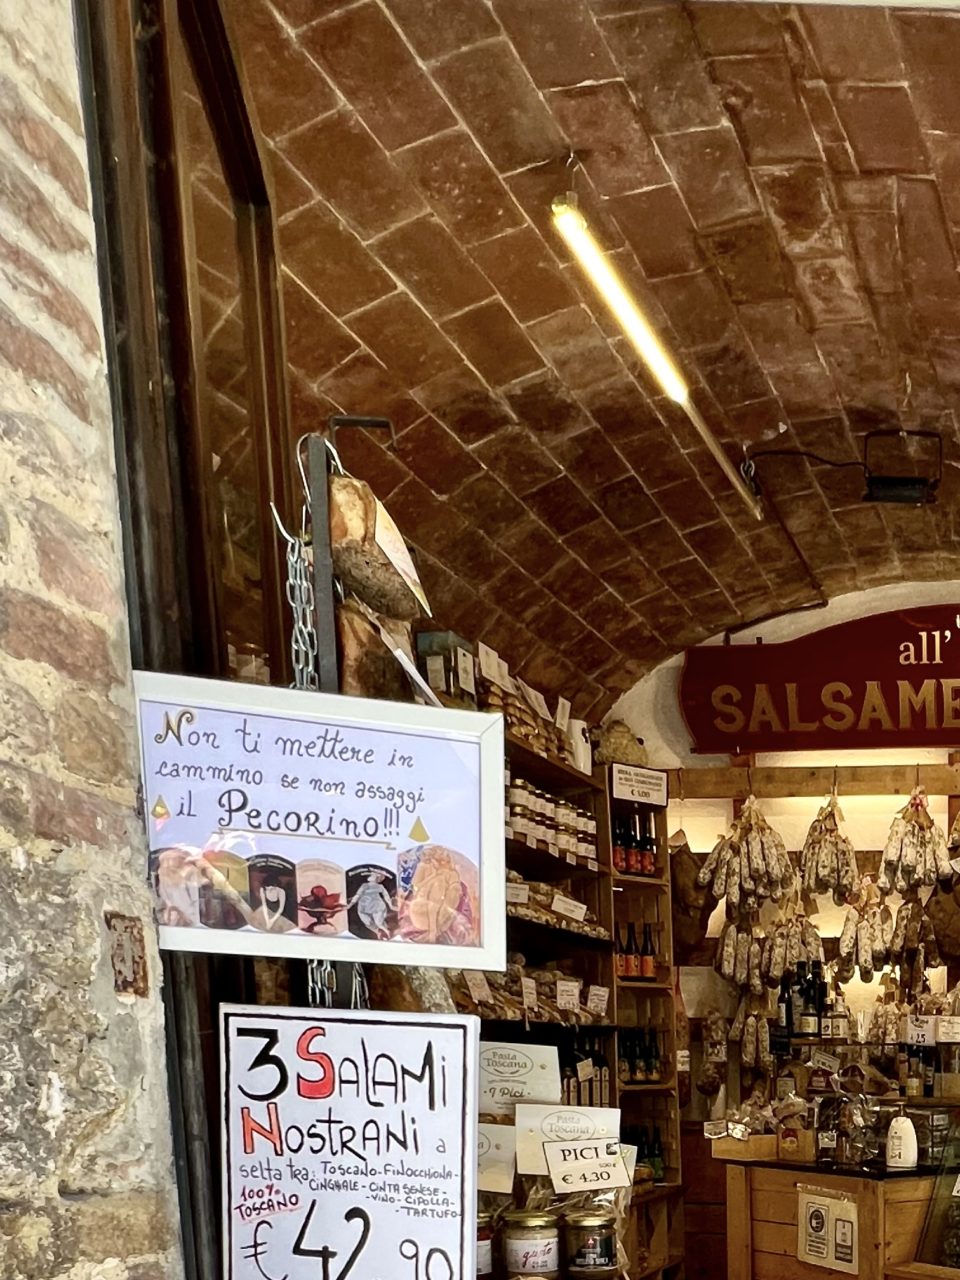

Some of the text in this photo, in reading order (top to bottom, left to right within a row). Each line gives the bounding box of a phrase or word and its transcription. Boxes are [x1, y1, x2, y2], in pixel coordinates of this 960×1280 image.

[154, 711, 414, 769] Non ti mettere in
[155, 760, 425, 814] cammino se non assaggi
[483, 1057, 527, 1069] Toscana
[492, 1051, 517, 1061] Pasta
[236, 1026, 447, 1111] 3 SALAMi
[499, 1086, 525, 1098] Pici
[556, 1115, 581, 1125] Pasta
[241, 1102, 447, 1162] NostRANi a
[546, 1123, 590, 1135] Toscana
[561, 1147, 600, 1162] PICI
[562, 1171, 611, 1184] € 4.30
[240, 1184, 281, 1202] 100%
[236, 1193, 302, 1222] TOSCANO
